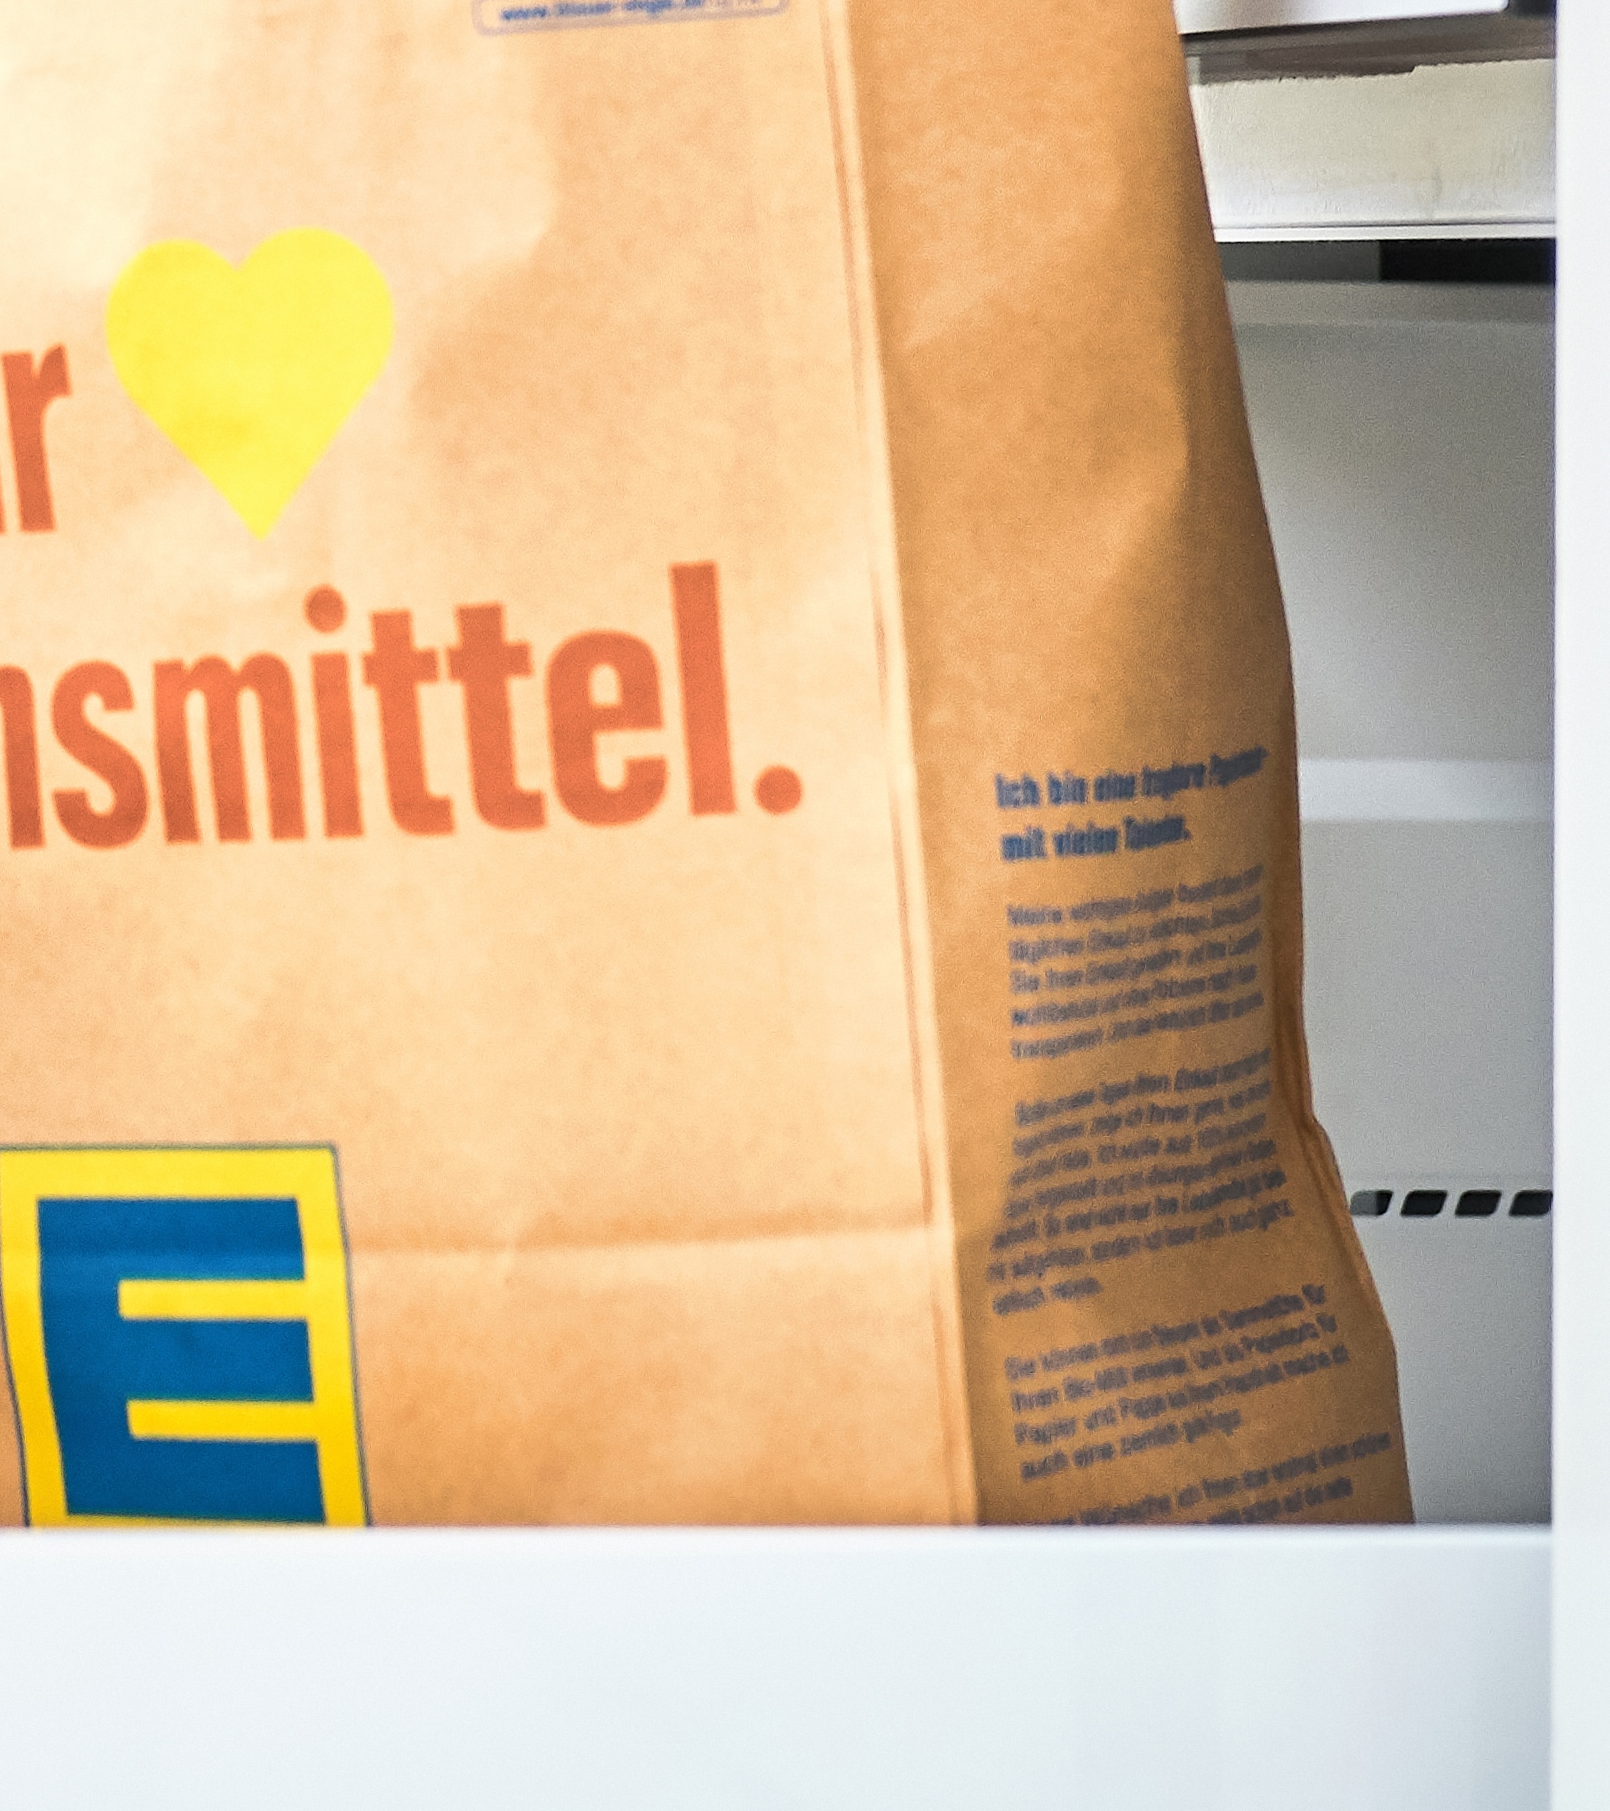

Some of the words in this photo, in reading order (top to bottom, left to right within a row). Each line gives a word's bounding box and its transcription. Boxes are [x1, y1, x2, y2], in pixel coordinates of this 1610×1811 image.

[994, 772, 1040, 809] Ich
[1047, 769, 1087, 805] bin
[1000, 825, 1047, 861] mit
[37, 1198, 327, 1525] E
